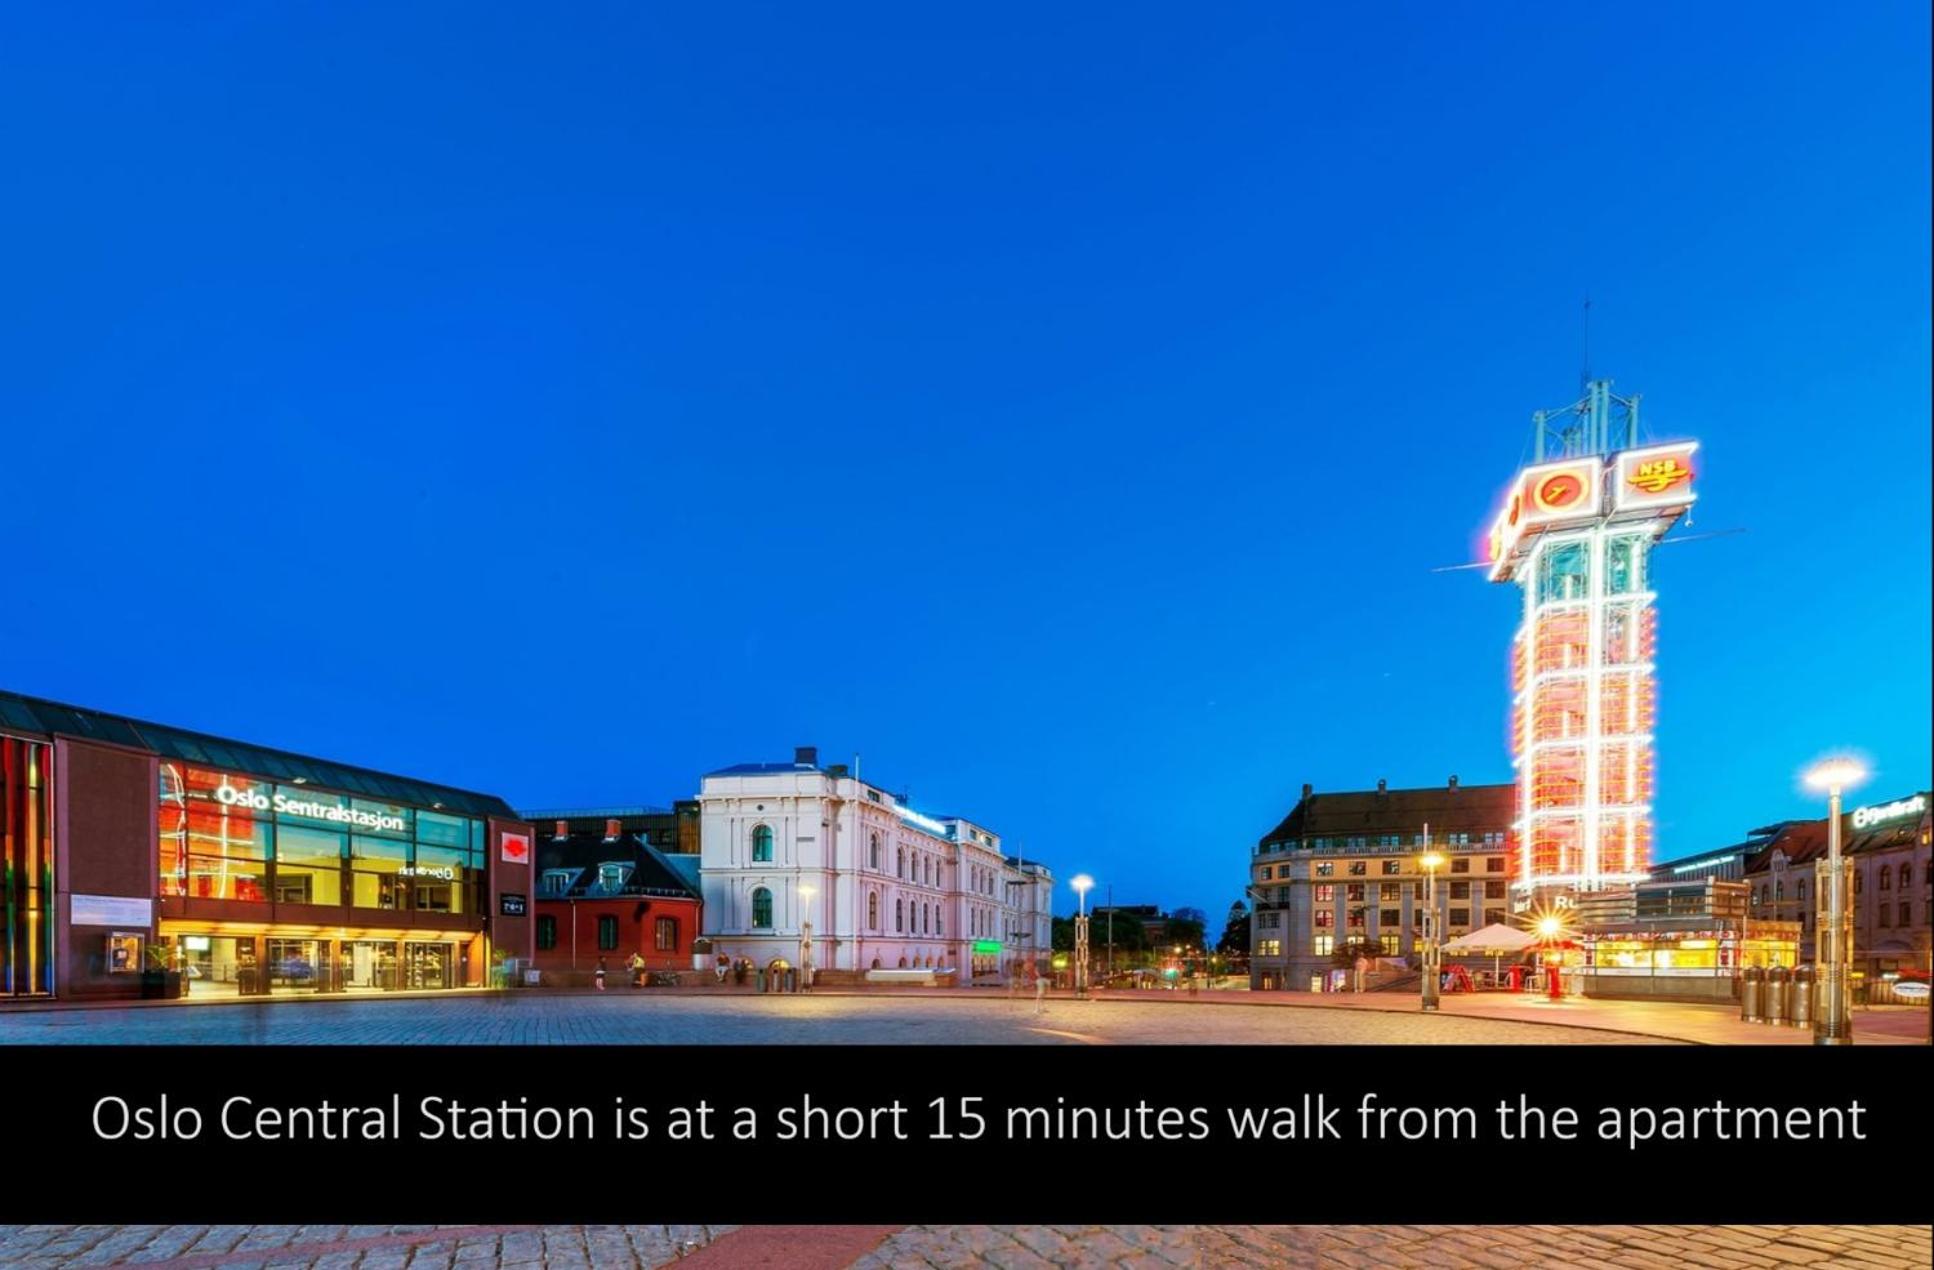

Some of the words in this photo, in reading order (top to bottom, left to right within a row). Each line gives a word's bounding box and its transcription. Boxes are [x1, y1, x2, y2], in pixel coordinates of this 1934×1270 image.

[1639, 459, 1677, 476] NSB
[217, 785, 270, 810] Oslo
[273, 794, 404, 831] Sentralstasjon
